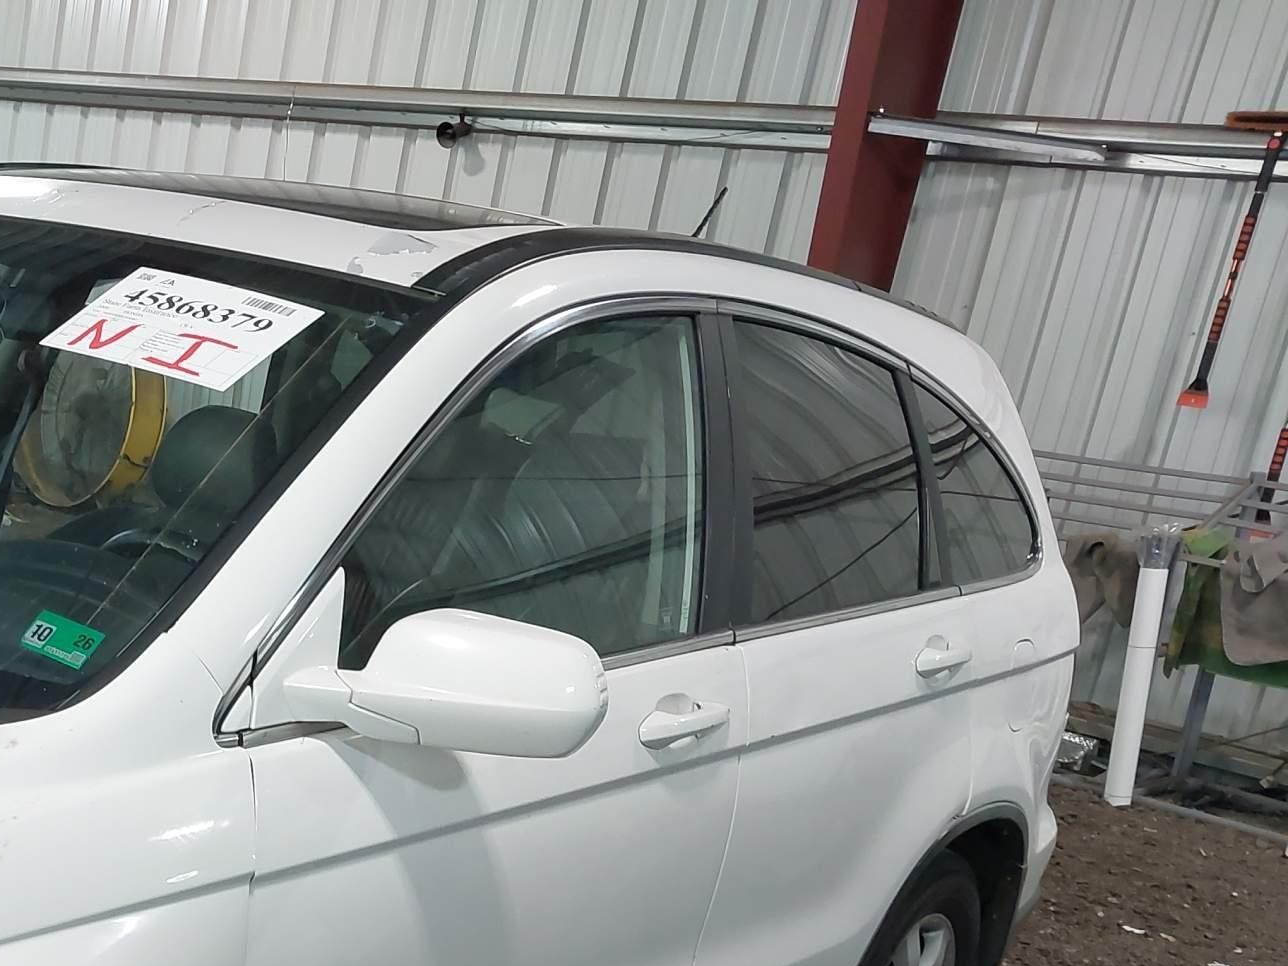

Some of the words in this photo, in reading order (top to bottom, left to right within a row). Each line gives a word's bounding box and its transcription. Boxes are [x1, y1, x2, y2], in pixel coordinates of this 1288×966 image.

[124, 288, 273, 333] 45868379
[30, 623, 54, 642] 10
[73, 634, 96, 651] 26
